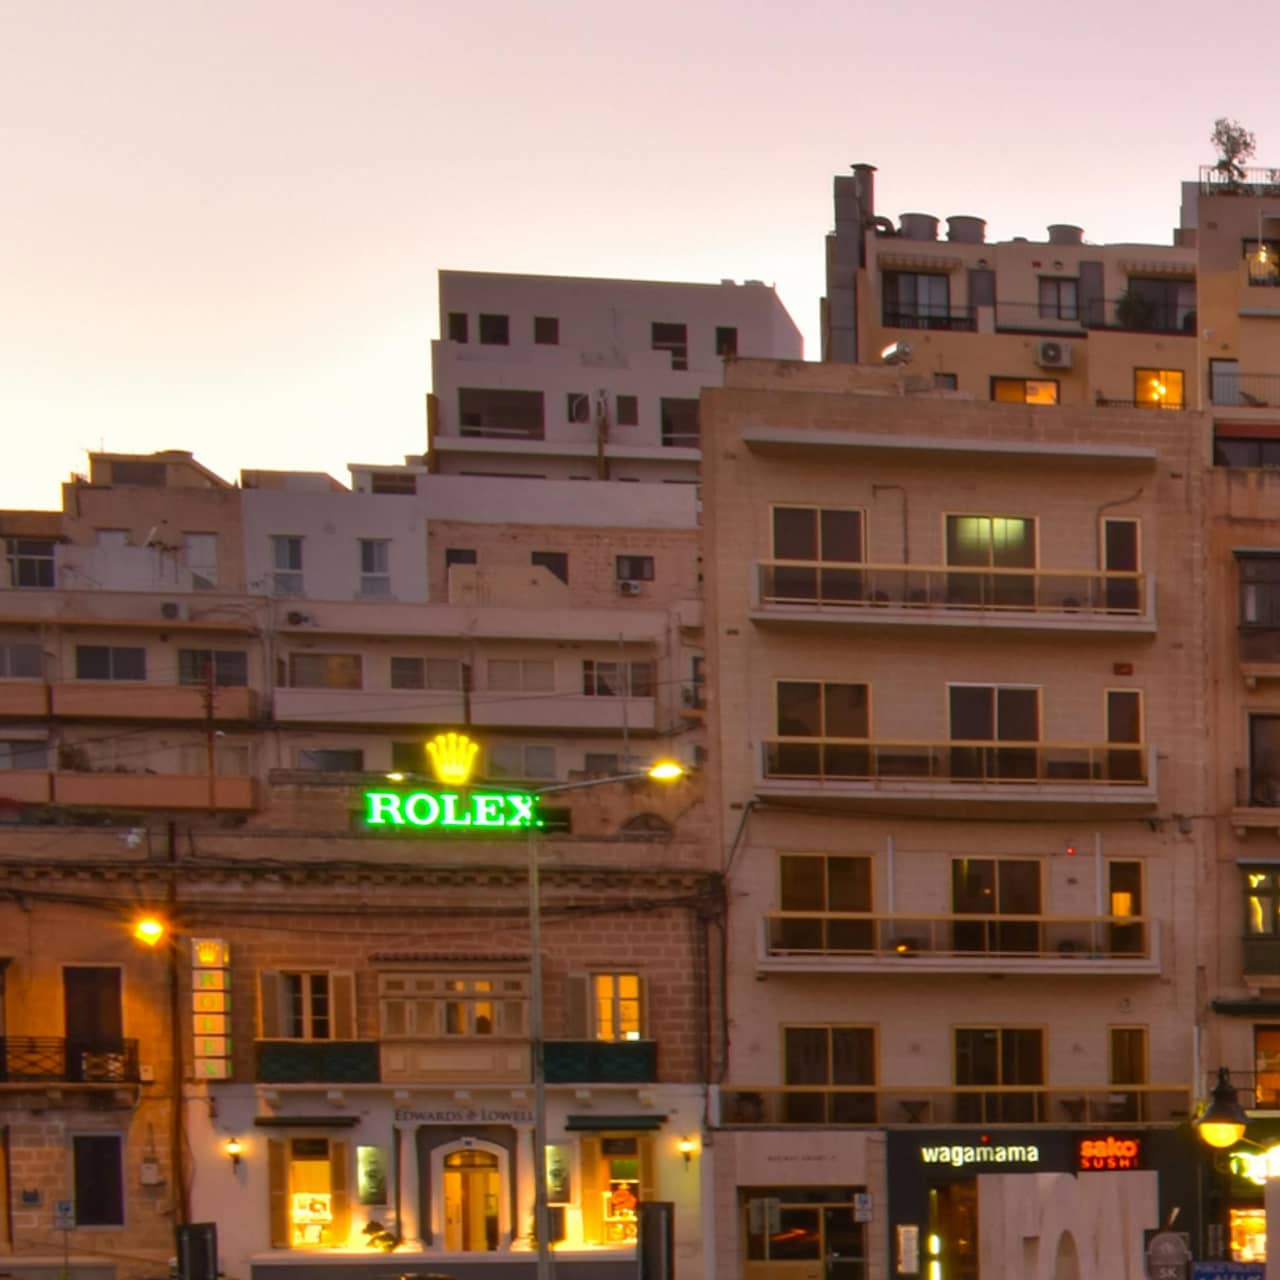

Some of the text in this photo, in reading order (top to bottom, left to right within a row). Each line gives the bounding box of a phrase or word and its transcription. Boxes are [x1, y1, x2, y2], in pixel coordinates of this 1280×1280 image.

[366, 792, 543, 827] ROLEX
[395, 1110, 462, 1121] EDWARDS
[482, 1109, 534, 1121] LOWELL
[921, 1145, 1040, 1167] wagamama
[1080, 1136, 1138, 1157] sako
